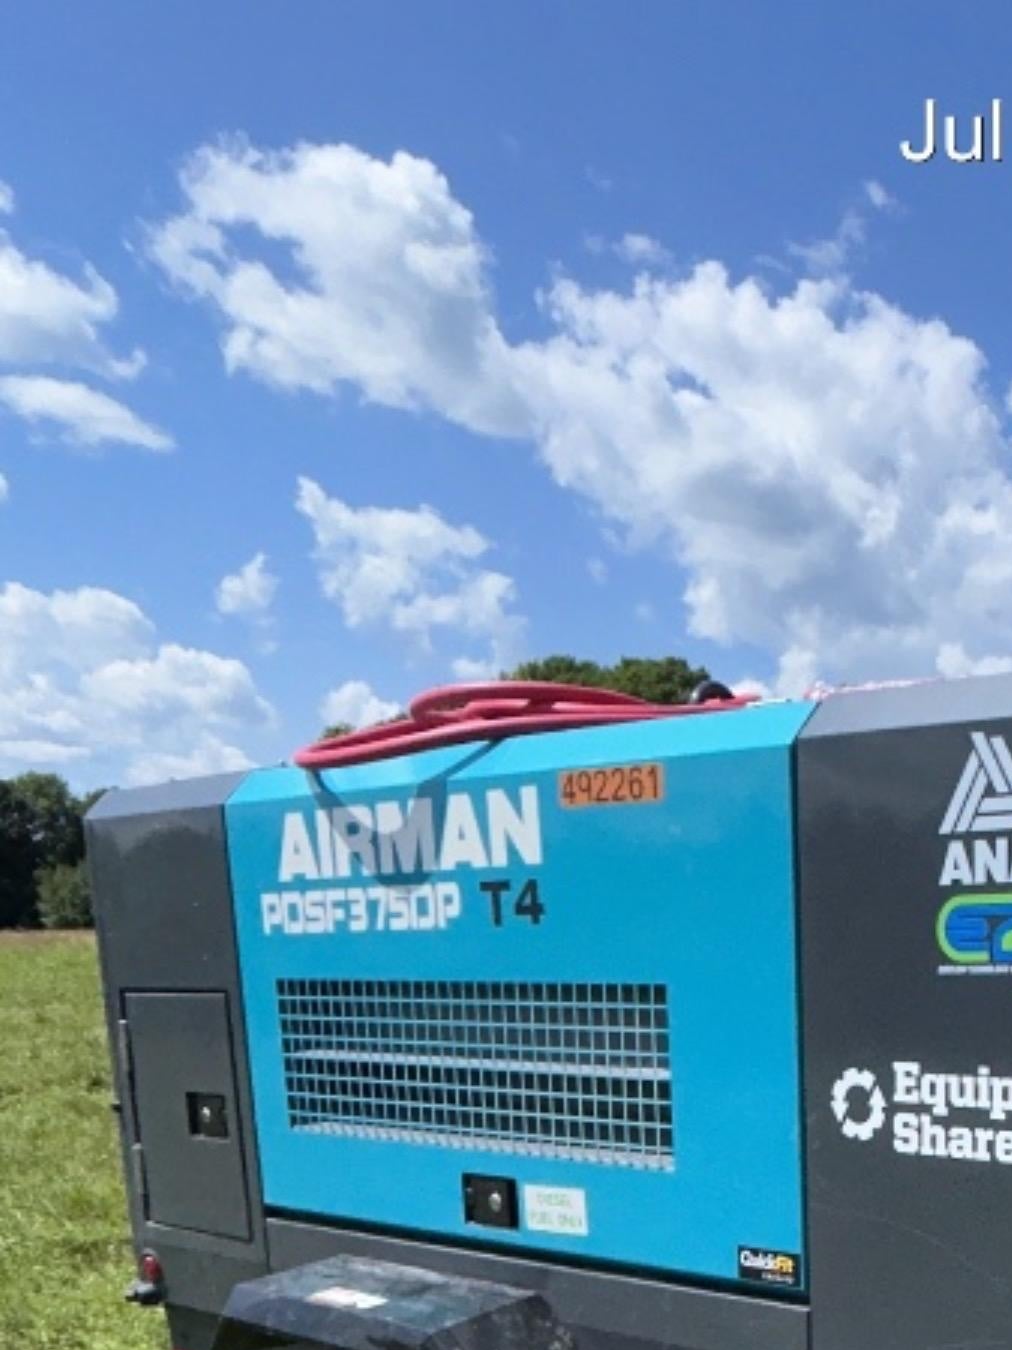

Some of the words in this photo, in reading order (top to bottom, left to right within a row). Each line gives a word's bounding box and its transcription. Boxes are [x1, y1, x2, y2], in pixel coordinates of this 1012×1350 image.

[563, 765, 658, 804] 492261
[278, 785, 542, 882] AIRMAN
[479, 878, 544, 926] T4
